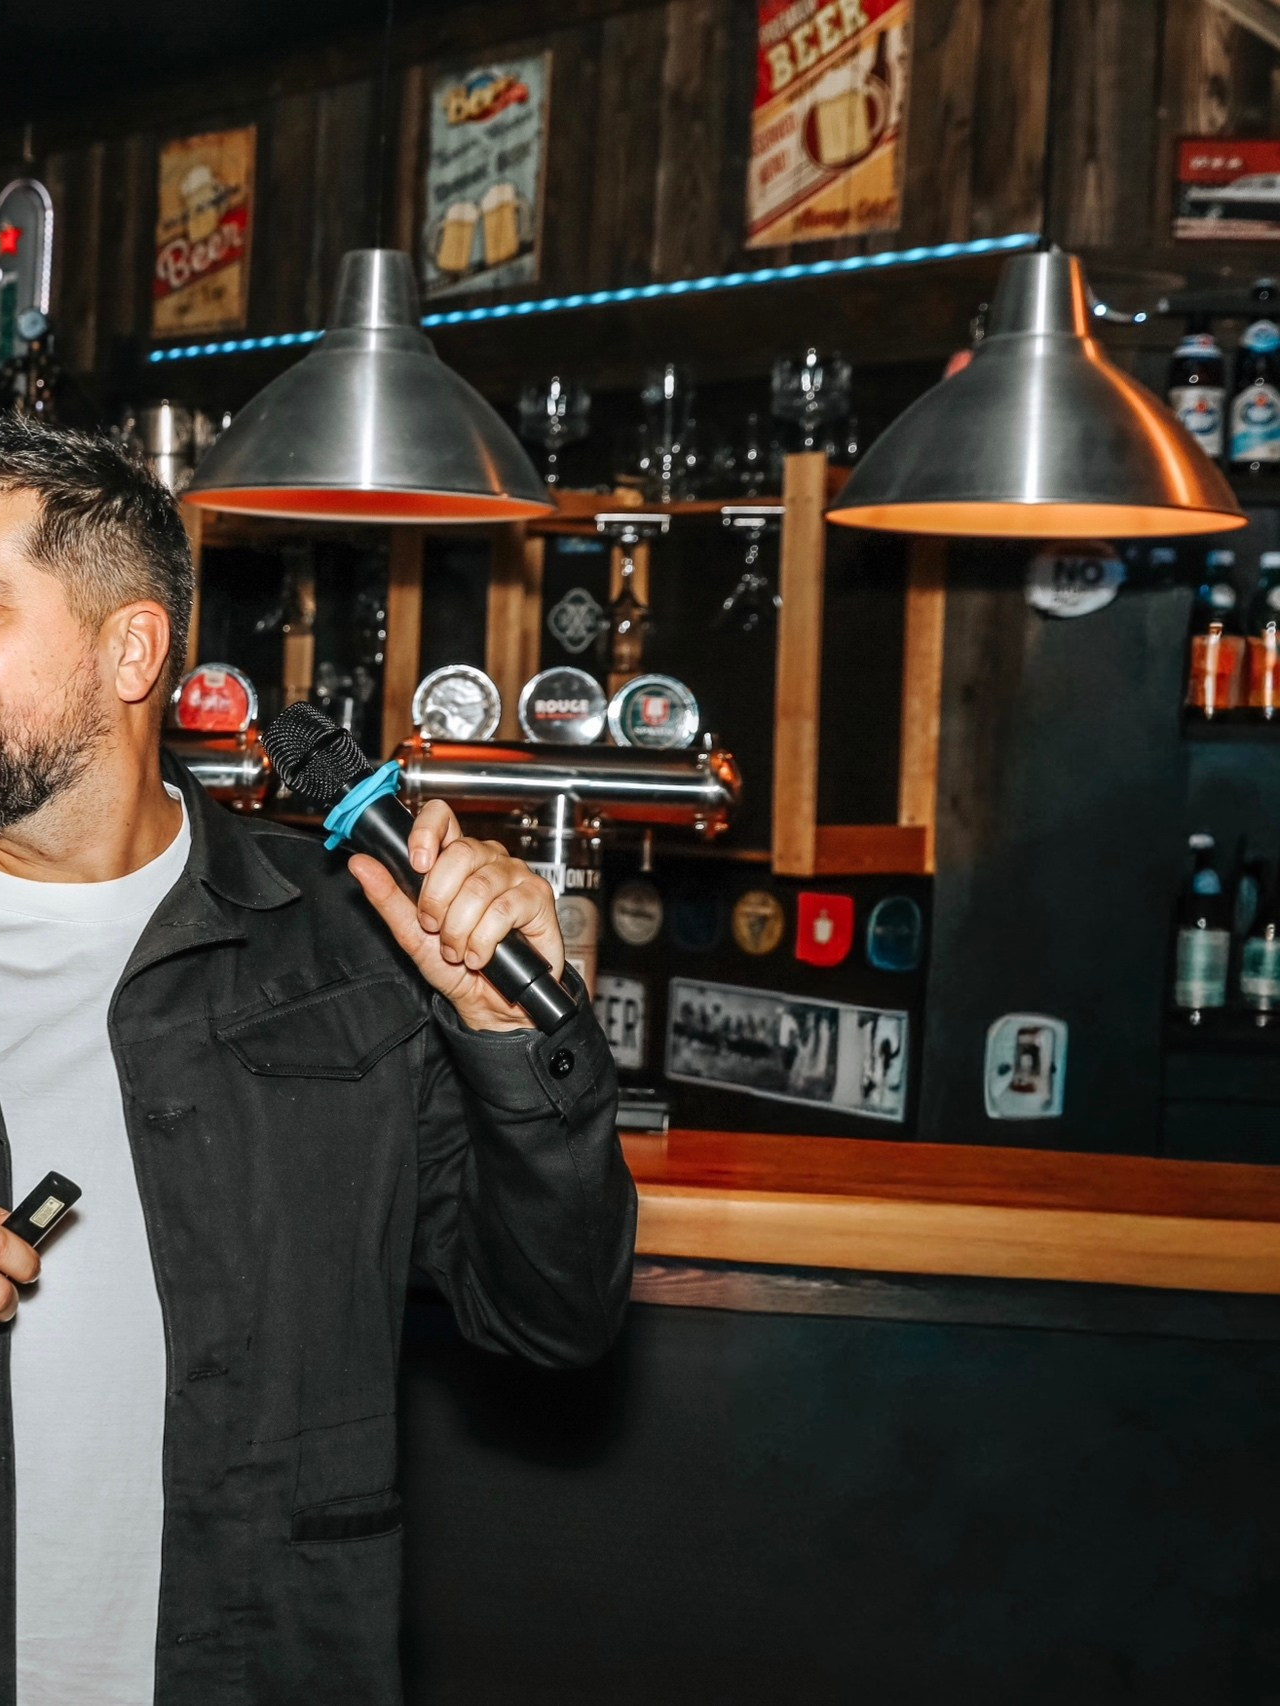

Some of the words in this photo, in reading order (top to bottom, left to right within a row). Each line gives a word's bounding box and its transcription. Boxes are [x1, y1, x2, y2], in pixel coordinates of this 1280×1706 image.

[768, 0, 869, 91] BEER
[157, 219, 241, 288] Beer
[534, 699, 589, 714] ROUGE
